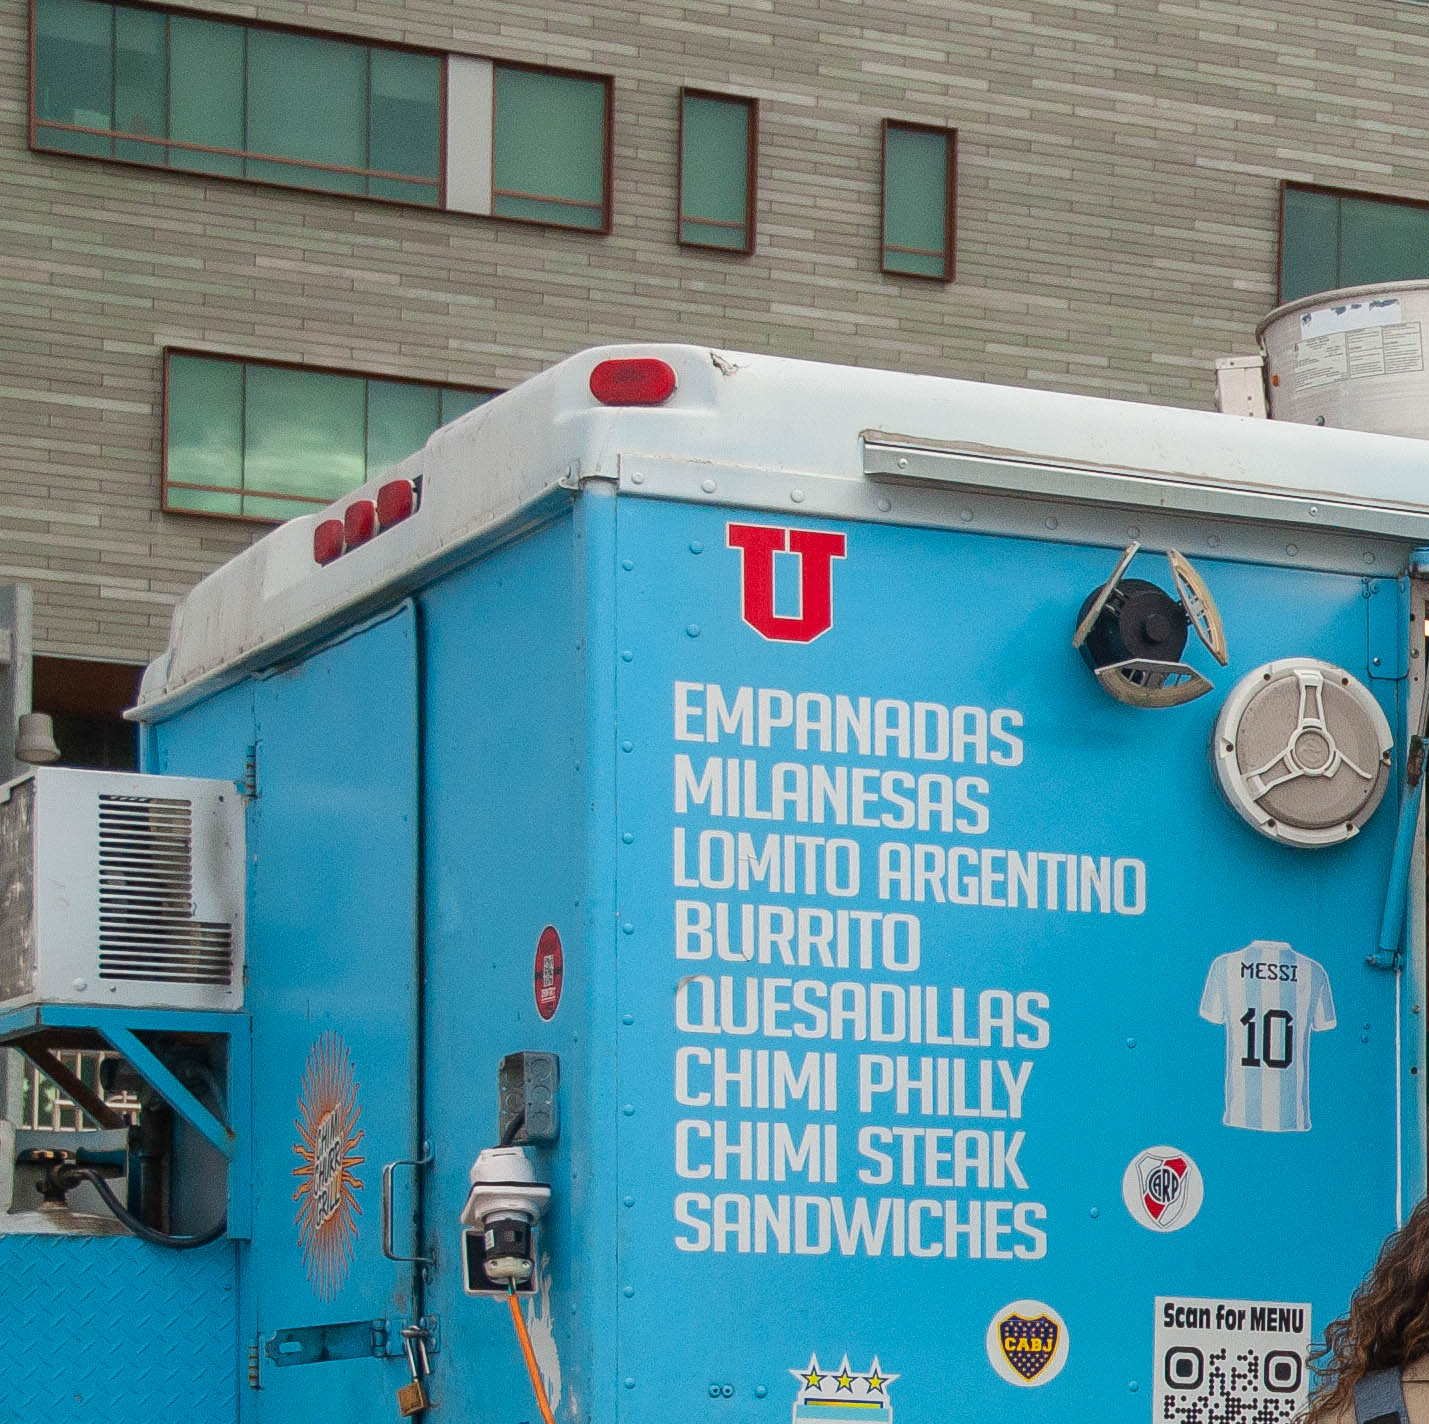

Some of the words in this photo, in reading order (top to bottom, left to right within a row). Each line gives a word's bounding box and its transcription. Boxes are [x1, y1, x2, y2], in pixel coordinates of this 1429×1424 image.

[727, 522, 847, 645] U
[674, 681, 1025, 768] EMPANADAS
[674, 755, 990, 835] MILANESAS
[674, 827, 862, 899] LOMITO
[879, 841, 1147, 915] ARGENTINO
[674, 899, 921, 973] BURRITO
[1241, 961, 1298, 982] MESSI
[676, 975, 1050, 1050] QUESADILLAS
[1240, 1008, 1294, 1068] 10
[674, 1046, 839, 1112] CHIMI
[860, 1054, 1035, 1120] PHILLY
[674, 1119, 839, 1185] CHIMI
[858, 1124, 1030, 1190] STEAK
[674, 1192, 1049, 1261] SANDWICHES
[1004, 1337, 1053, 1353] CABJ
[1163, 1302, 1207, 1329] Scan
[1216, 1304, 1246, 1332] for
[1250, 1306, 1305, 1334] MENU
